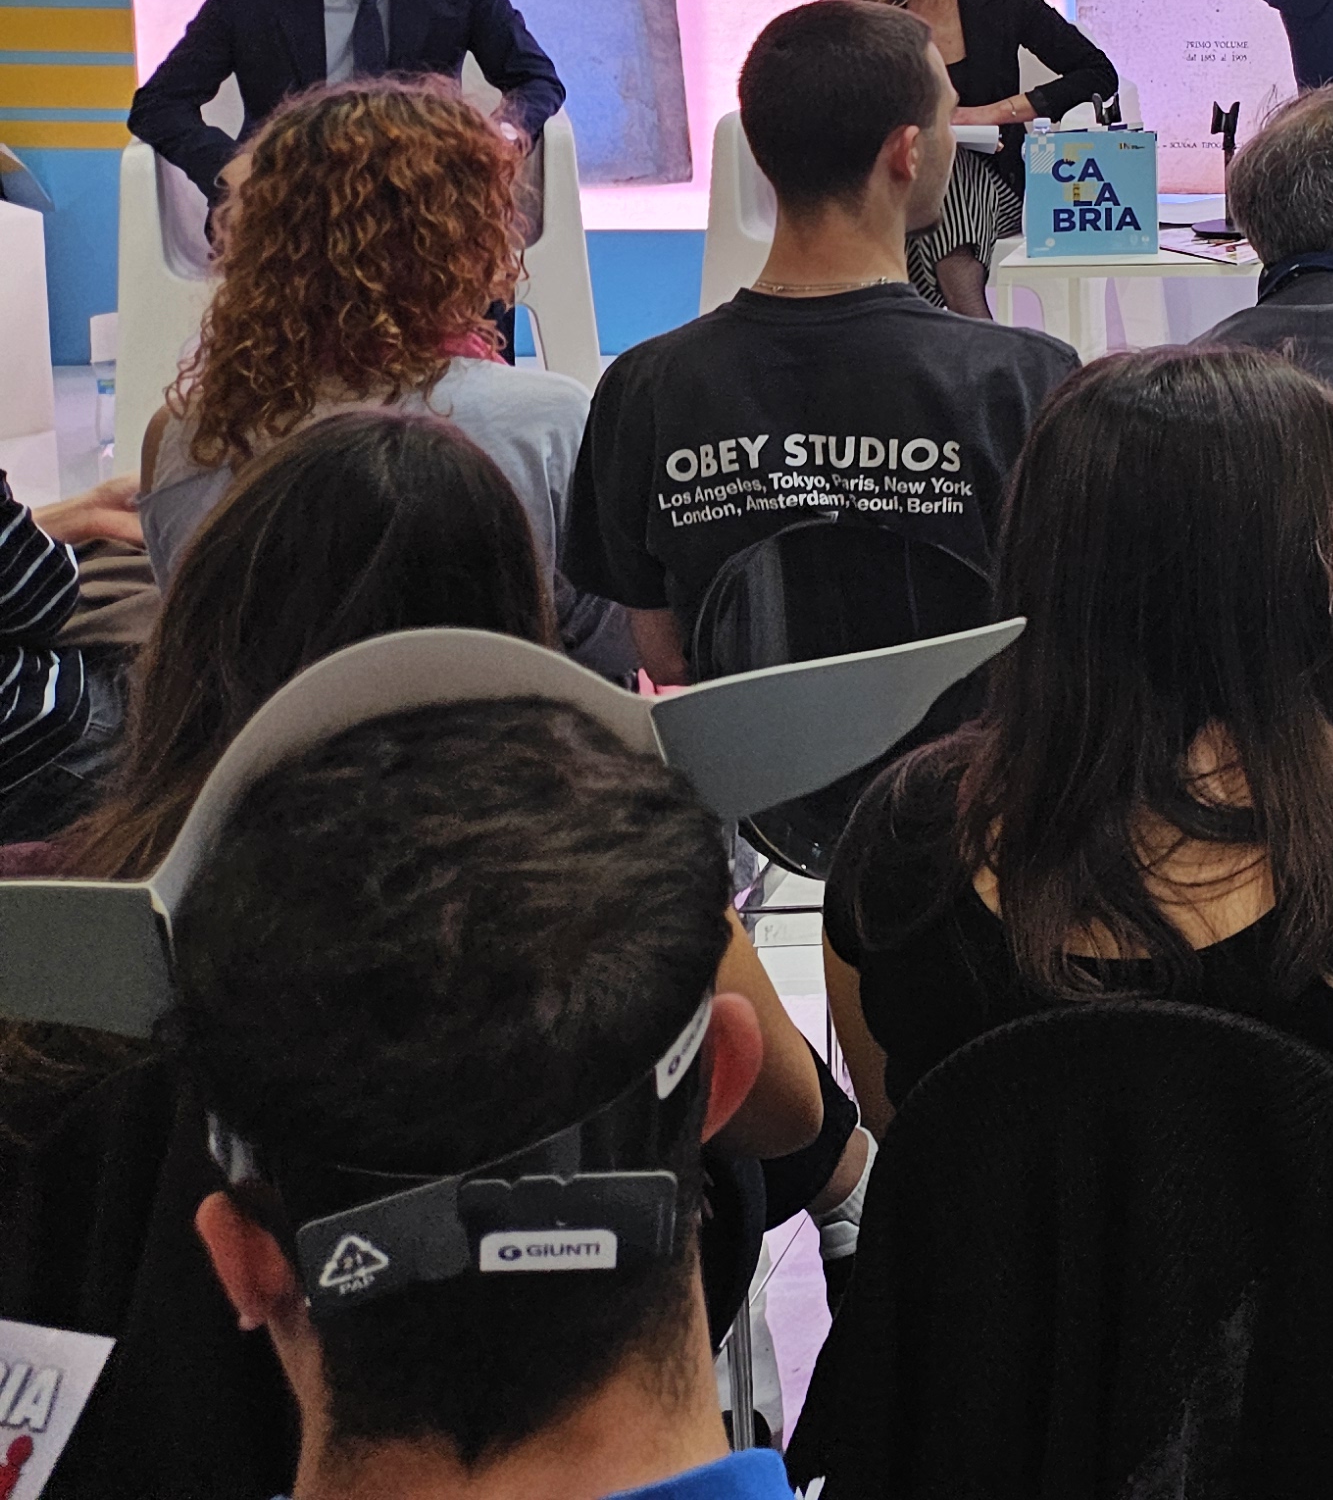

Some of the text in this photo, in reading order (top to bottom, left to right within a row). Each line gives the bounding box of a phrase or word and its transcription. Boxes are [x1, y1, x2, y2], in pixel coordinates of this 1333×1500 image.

[1052, 158, 1104, 182] CA
[1073, 182, 1121, 207] LA
[1053, 207, 1142, 232] BRIA
[665, 433, 961, 482] OBEY STUDIOS
[659, 491, 692, 510] Los
[693, 476, 767, 504] Angeles,
[768, 472, 831, 492] Tokyo,
[884, 475, 926, 496] New
[931, 480, 973, 497] York
[671, 504, 742, 527] London,
[746, 491, 850, 512] Amsterdam,
[907, 498, 964, 515] Berlin
[526, 1243, 600, 1257] GIUNTI
